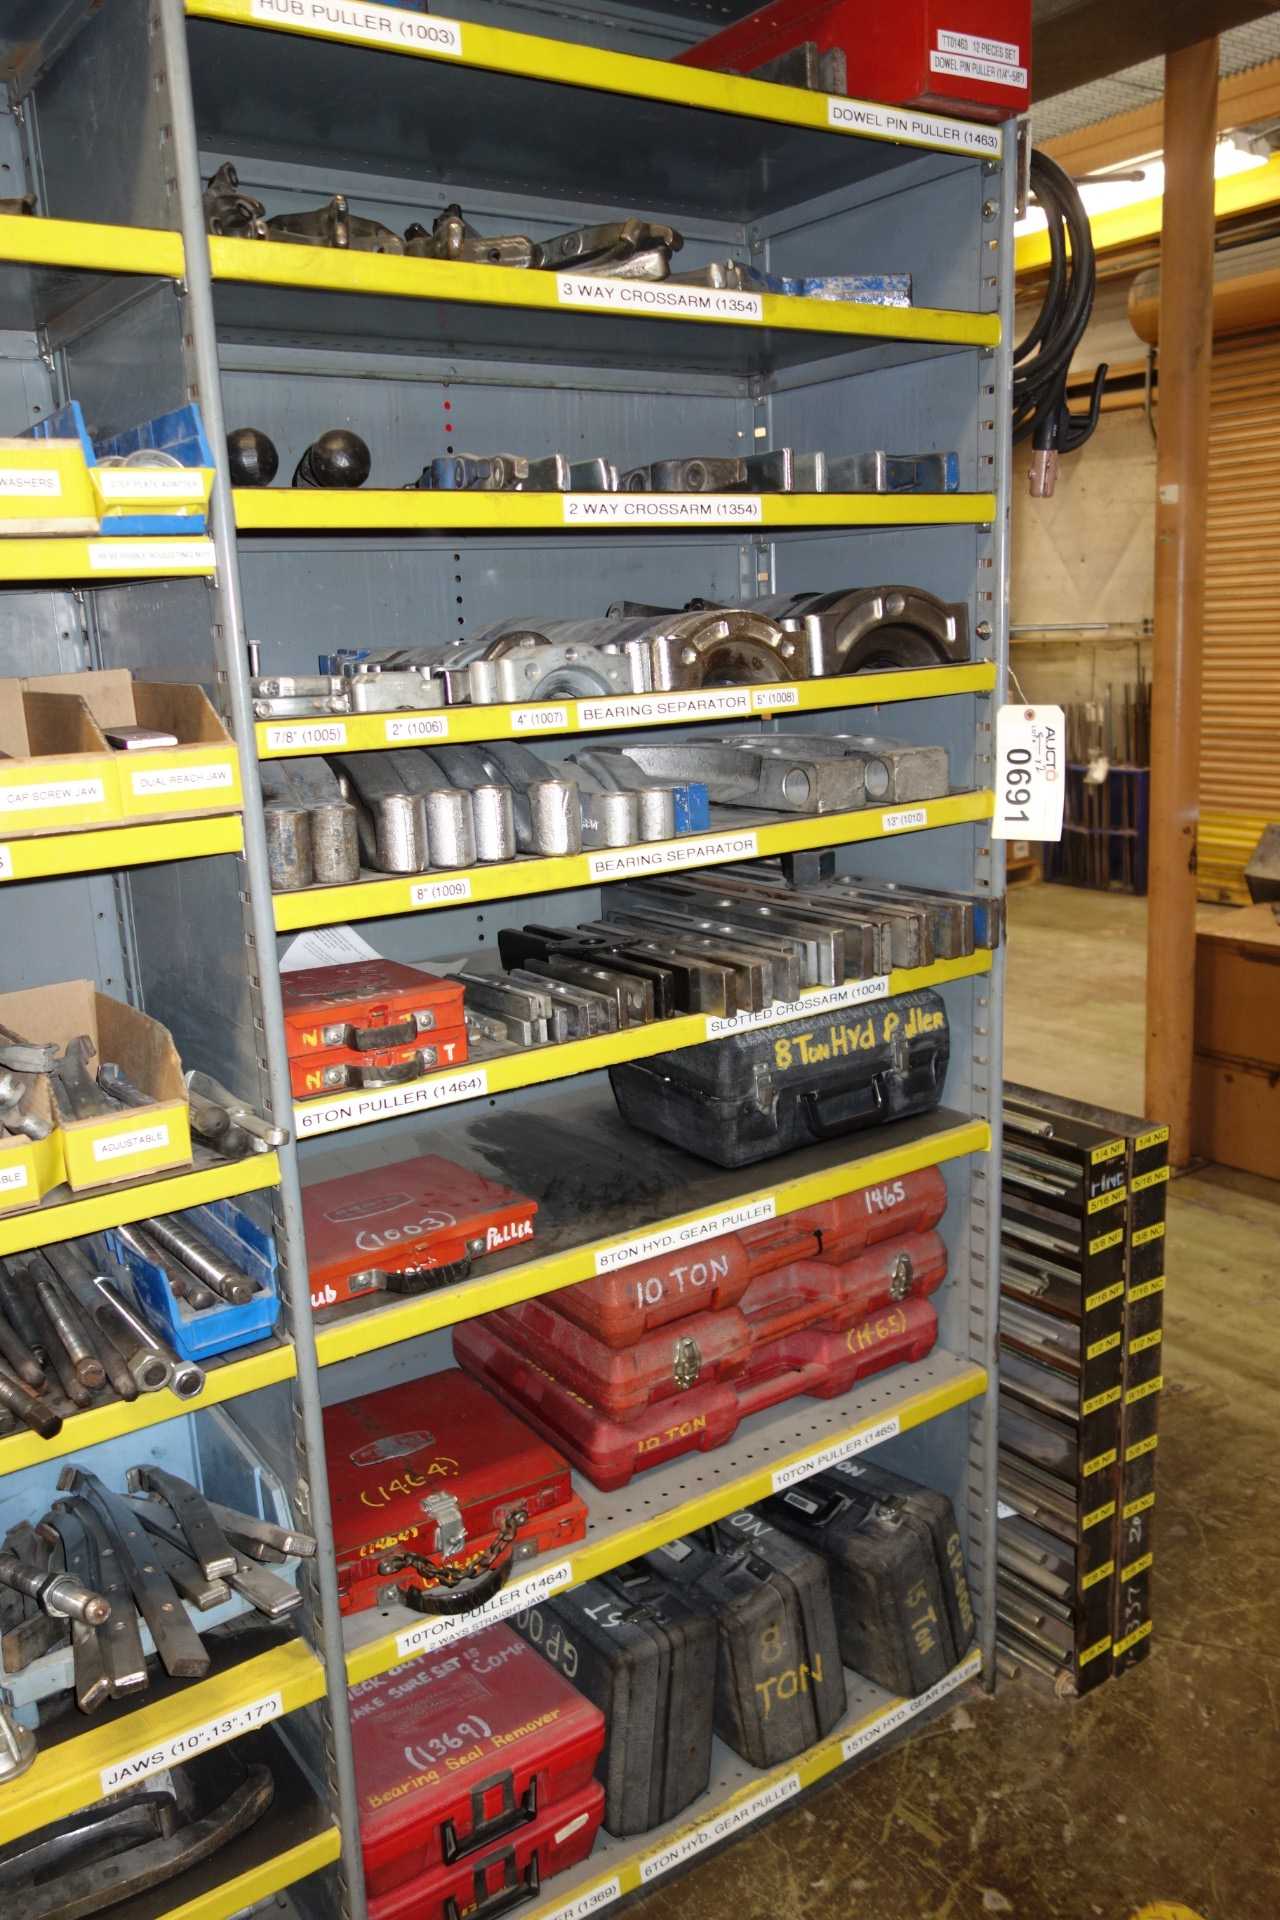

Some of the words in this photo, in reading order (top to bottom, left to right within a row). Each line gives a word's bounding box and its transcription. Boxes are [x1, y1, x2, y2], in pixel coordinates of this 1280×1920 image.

[312, 4, 392, 32] PULLER
[399, 23, 455, 45] (1003)
[934, 56, 959, 72] DOWEL
[960, 62, 971, 74] PIN
[971, 64, 996, 79] PULLER
[981, 43, 1004, 58] PIECES
[1004, 49, 1016, 61] SET
[833, 107, 882, 127] DOWEL
[886, 117, 908, 131] PIN
[912, 122, 960, 142] PULLER
[964, 133, 998, 150] (1463)
[563, 282, 574, 296] 3
[578, 284, 615, 300] WAY
[620, 288, 712, 309] CROSSARM
[716, 298, 759, 314] (1354)
[569, 502, 579, 515] 2
[583, 502, 619, 515] WAY
[624, 502, 713, 515] CROSSARM
[716, 502, 759, 516] (1354)
[584, 703, 653, 721] BEARING
[656, 696, 747, 715] SEPARATOR
[768, 692, 795, 705] (1008)
[407, 721, 444, 735] (1006)
[531, 711, 564, 726] (1007)
[302, 729, 342, 743] (1005)
[1045, 726, 1057, 782] AUCTO
[32, 789, 72, 802] SCREW
[75, 787, 97, 798] JAW
[140, 776, 167, 788] DUAL
[169, 774, 203, 785] REACH
[206, 771, 227, 782] JAW
[1004, 747, 1032, 822] 0691
[595, 852, 663, 872] BEARING
[666, 838, 754, 863] SEPARATOR
[432, 883, 466, 898] (1009)
[711, 1008, 773, 1032] SLOTTED
[777, 990, 848, 1016] CROSSARM
[852, 981, 886, 1000] (1004)
[774, 1038, 792, 1071] 8
[302, 1106, 352, 1128] 6TON
[358, 1086, 428, 1114] PULLER
[433, 1077, 482, 1099] (1464)
[101, 1132, 164, 1153] ADJUSTABLE
[864, 1181, 906, 1214] 1465
[356, 1210, 457, 1251] (1003)
[600, 1246, 638, 1267] 8TON
[643, 1235, 676, 1253] HYD.
[680, 1221, 719, 1242] GEAR
[722, 1202, 772, 1229] PULLER
[311, 1283, 337, 1308] ub
[636, 1278, 664, 1309] 10
[669, 1255, 729, 1294] TON
[665, 1415, 707, 1441] TON
[776, 1460, 815, 1485] 10TON
[818, 1439, 862, 1464] PULLER
[403, 1617, 456, 1648] 10TON
[460, 1588, 521, 1623] PULLER
[525, 1568, 569, 1595] (1464)
[437, 1627, 470, 1646] WAYS
[473, 1607, 522, 1632] STRAIGHT
[525, 1592, 547, 1608] JAW
[353, 1698, 385, 1721] AKE
[388, 1672, 432, 1698] SURE
[431, 1657, 463, 1679] SET
[755, 1652, 823, 1720] TON
[846, 1727, 881, 1753] 15TON
[910, 1689, 940, 1712] GEAR
[368, 1769, 441, 1809] Bearing
[445, 1744, 485, 1771] Seal
[491, 1708, 561, 1749] Remover
[404, 1714, 492, 1771] (1369)
[108, 1751, 164, 1785] JAWS
[644, 1849, 680, 1877] 6TON
[682, 1831, 712, 1855] HYD.
[714, 1807, 751, 1835] GEAR
[752, 1779, 798, 1813] PULLER
[577, 1884, 617, 1913] (1369)
